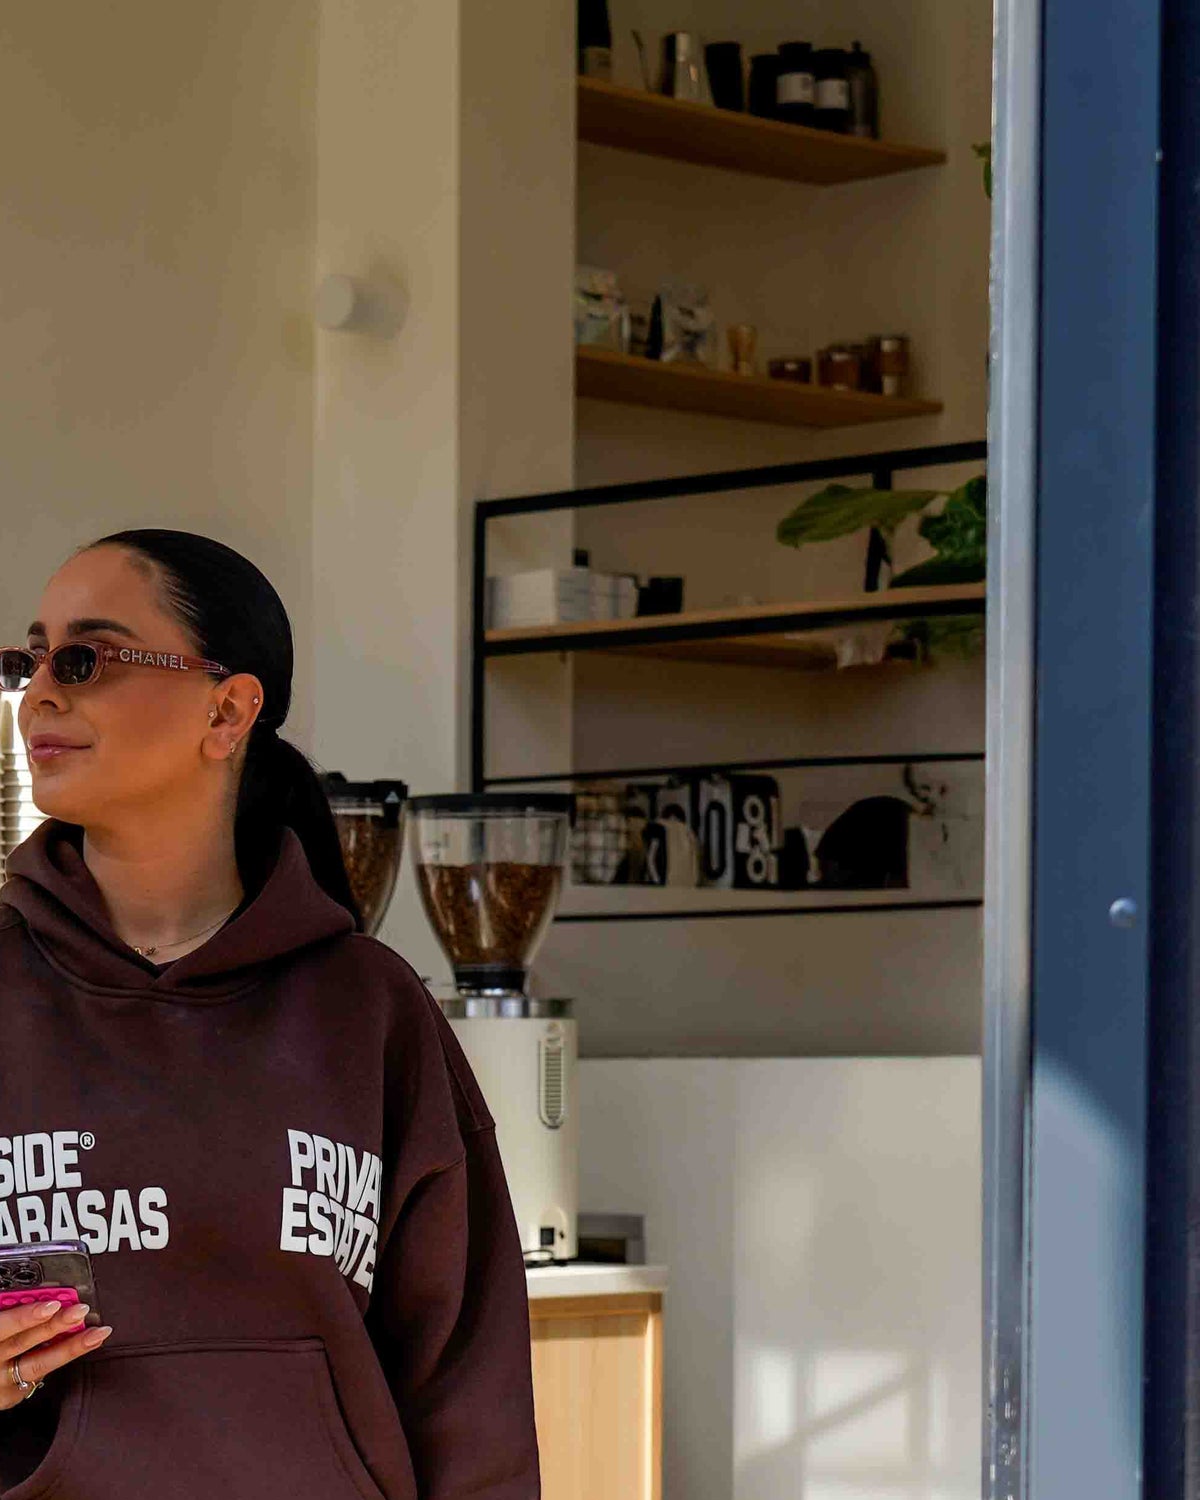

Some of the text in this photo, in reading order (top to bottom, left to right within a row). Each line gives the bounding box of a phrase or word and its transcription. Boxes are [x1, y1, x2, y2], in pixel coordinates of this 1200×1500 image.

[119, 648, 189, 670] CHANEL
[287, 1128, 383, 1225] PRIVA
[279, 1187, 379, 1295] ESTATE
